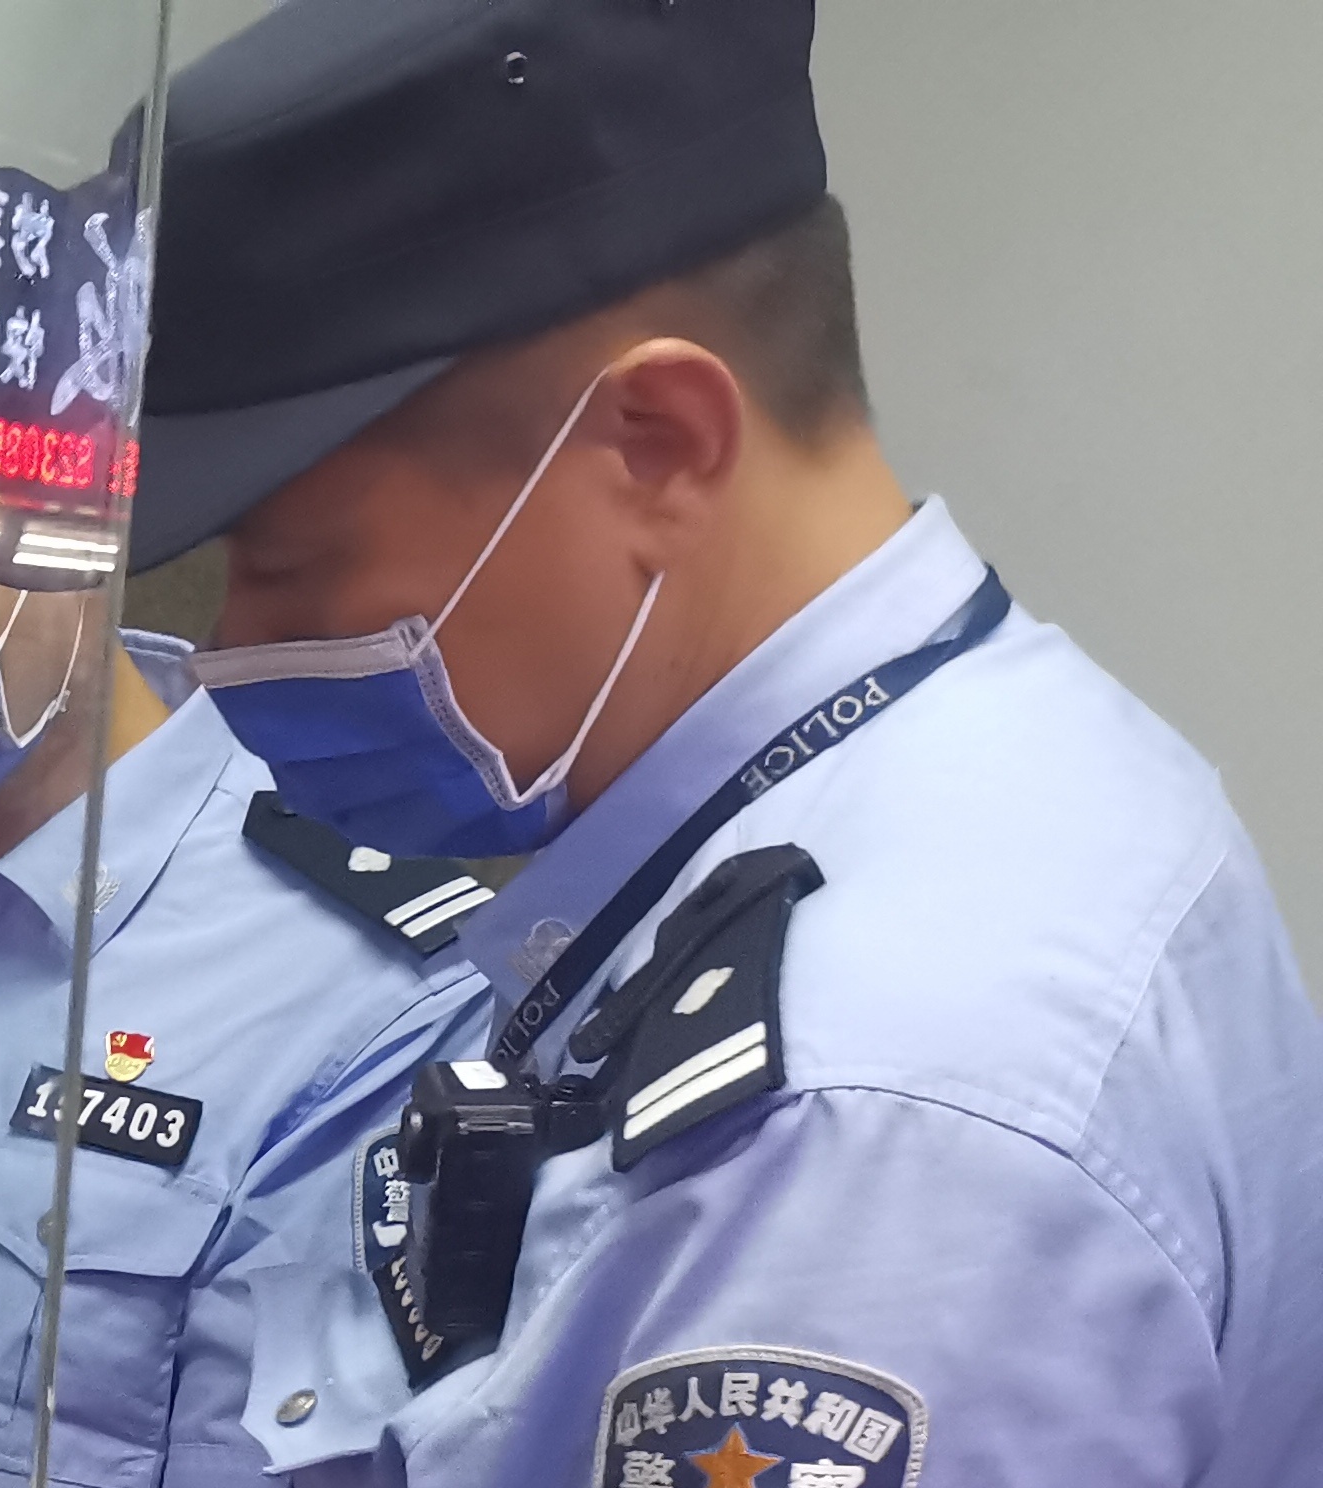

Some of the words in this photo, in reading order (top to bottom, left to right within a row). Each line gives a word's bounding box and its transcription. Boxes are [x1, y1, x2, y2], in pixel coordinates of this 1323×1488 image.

[741, 677, 890, 797] POLICE
[614, 1373, 905, 1463] 中华人民共和国
